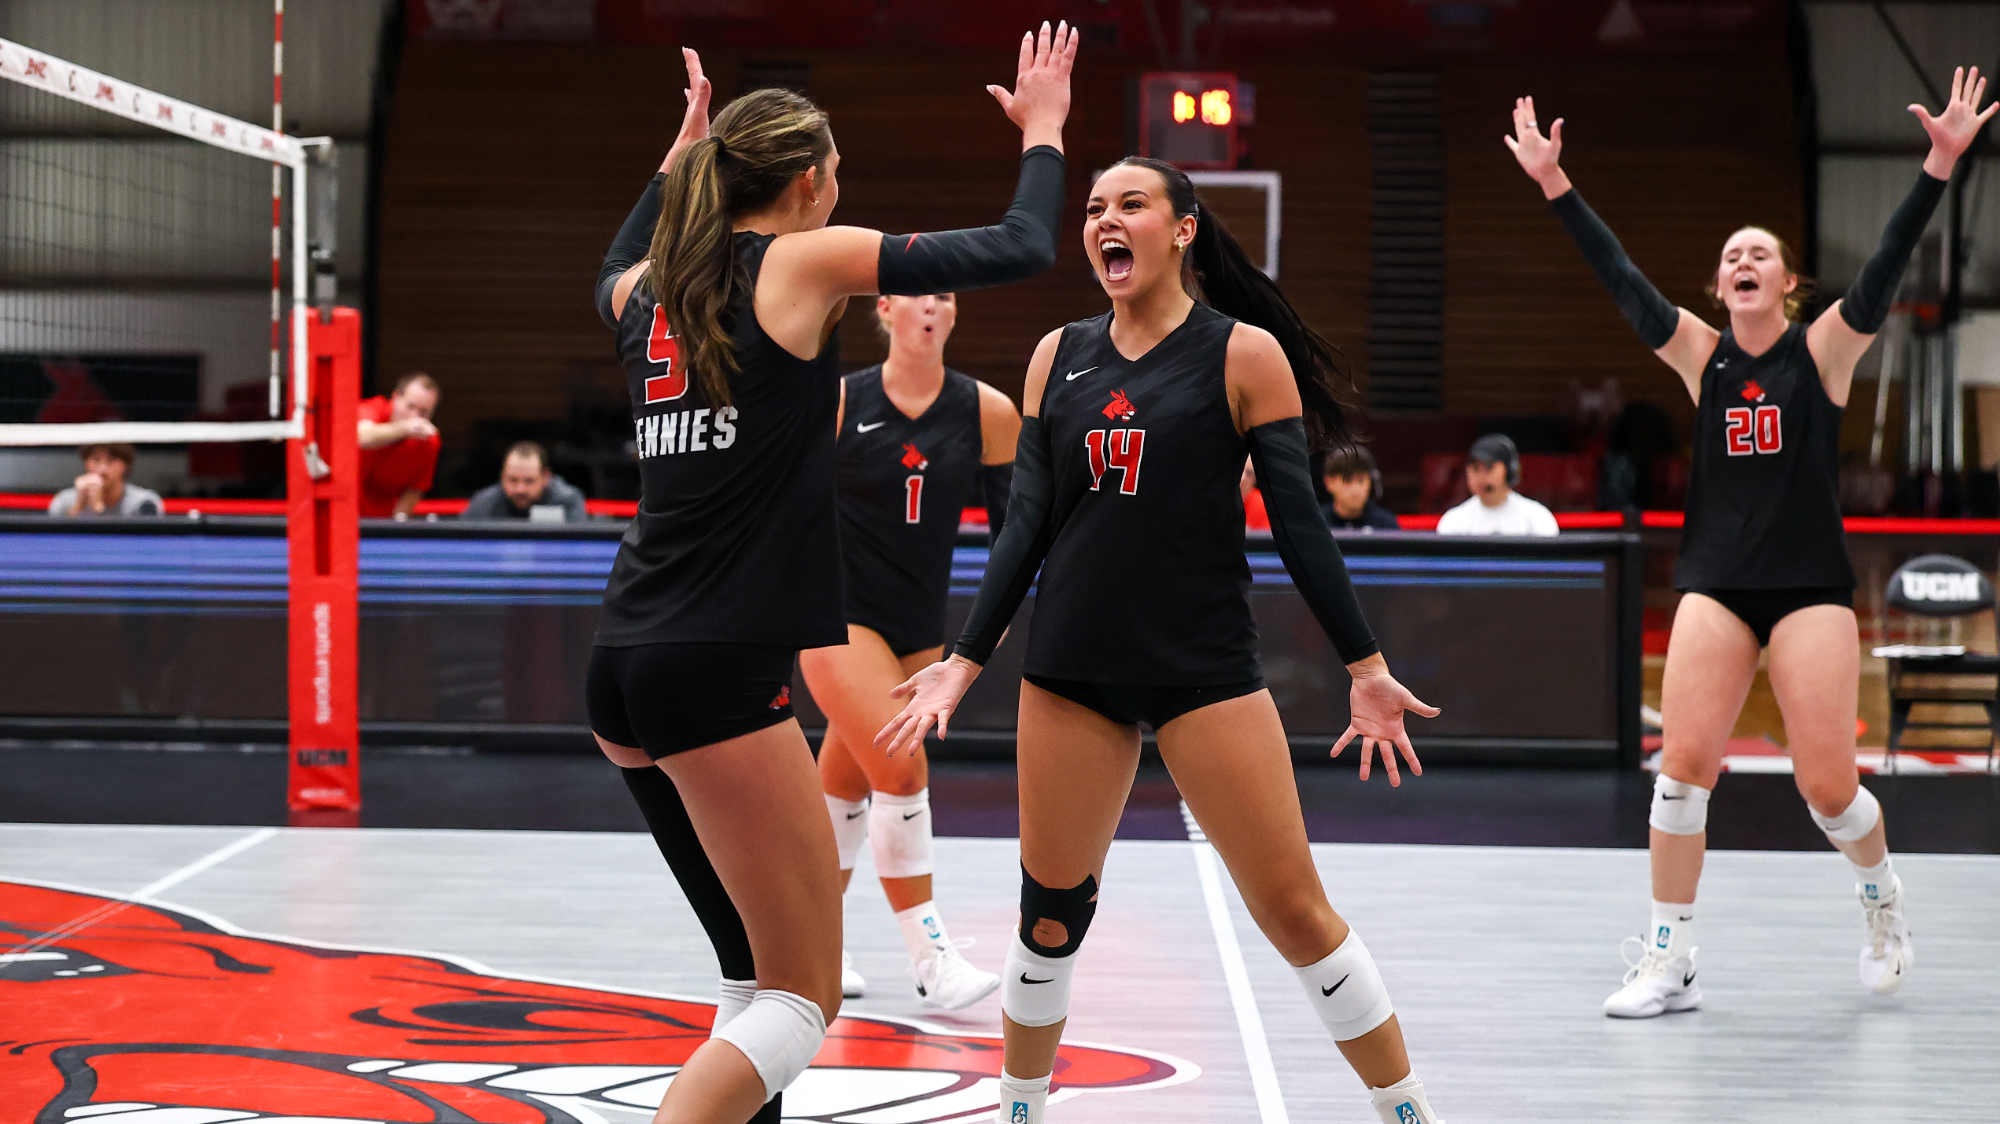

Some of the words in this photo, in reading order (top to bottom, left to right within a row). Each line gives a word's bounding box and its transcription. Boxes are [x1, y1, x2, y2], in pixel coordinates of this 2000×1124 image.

[644, 302, 689, 405] 5
[634, 405, 739, 460] ENNIES
[1725, 404, 1782, 456] 20
[1085, 428, 1146, 495] 14
[905, 474, 924, 524] 1
[1900, 570, 1981, 601] UCM
